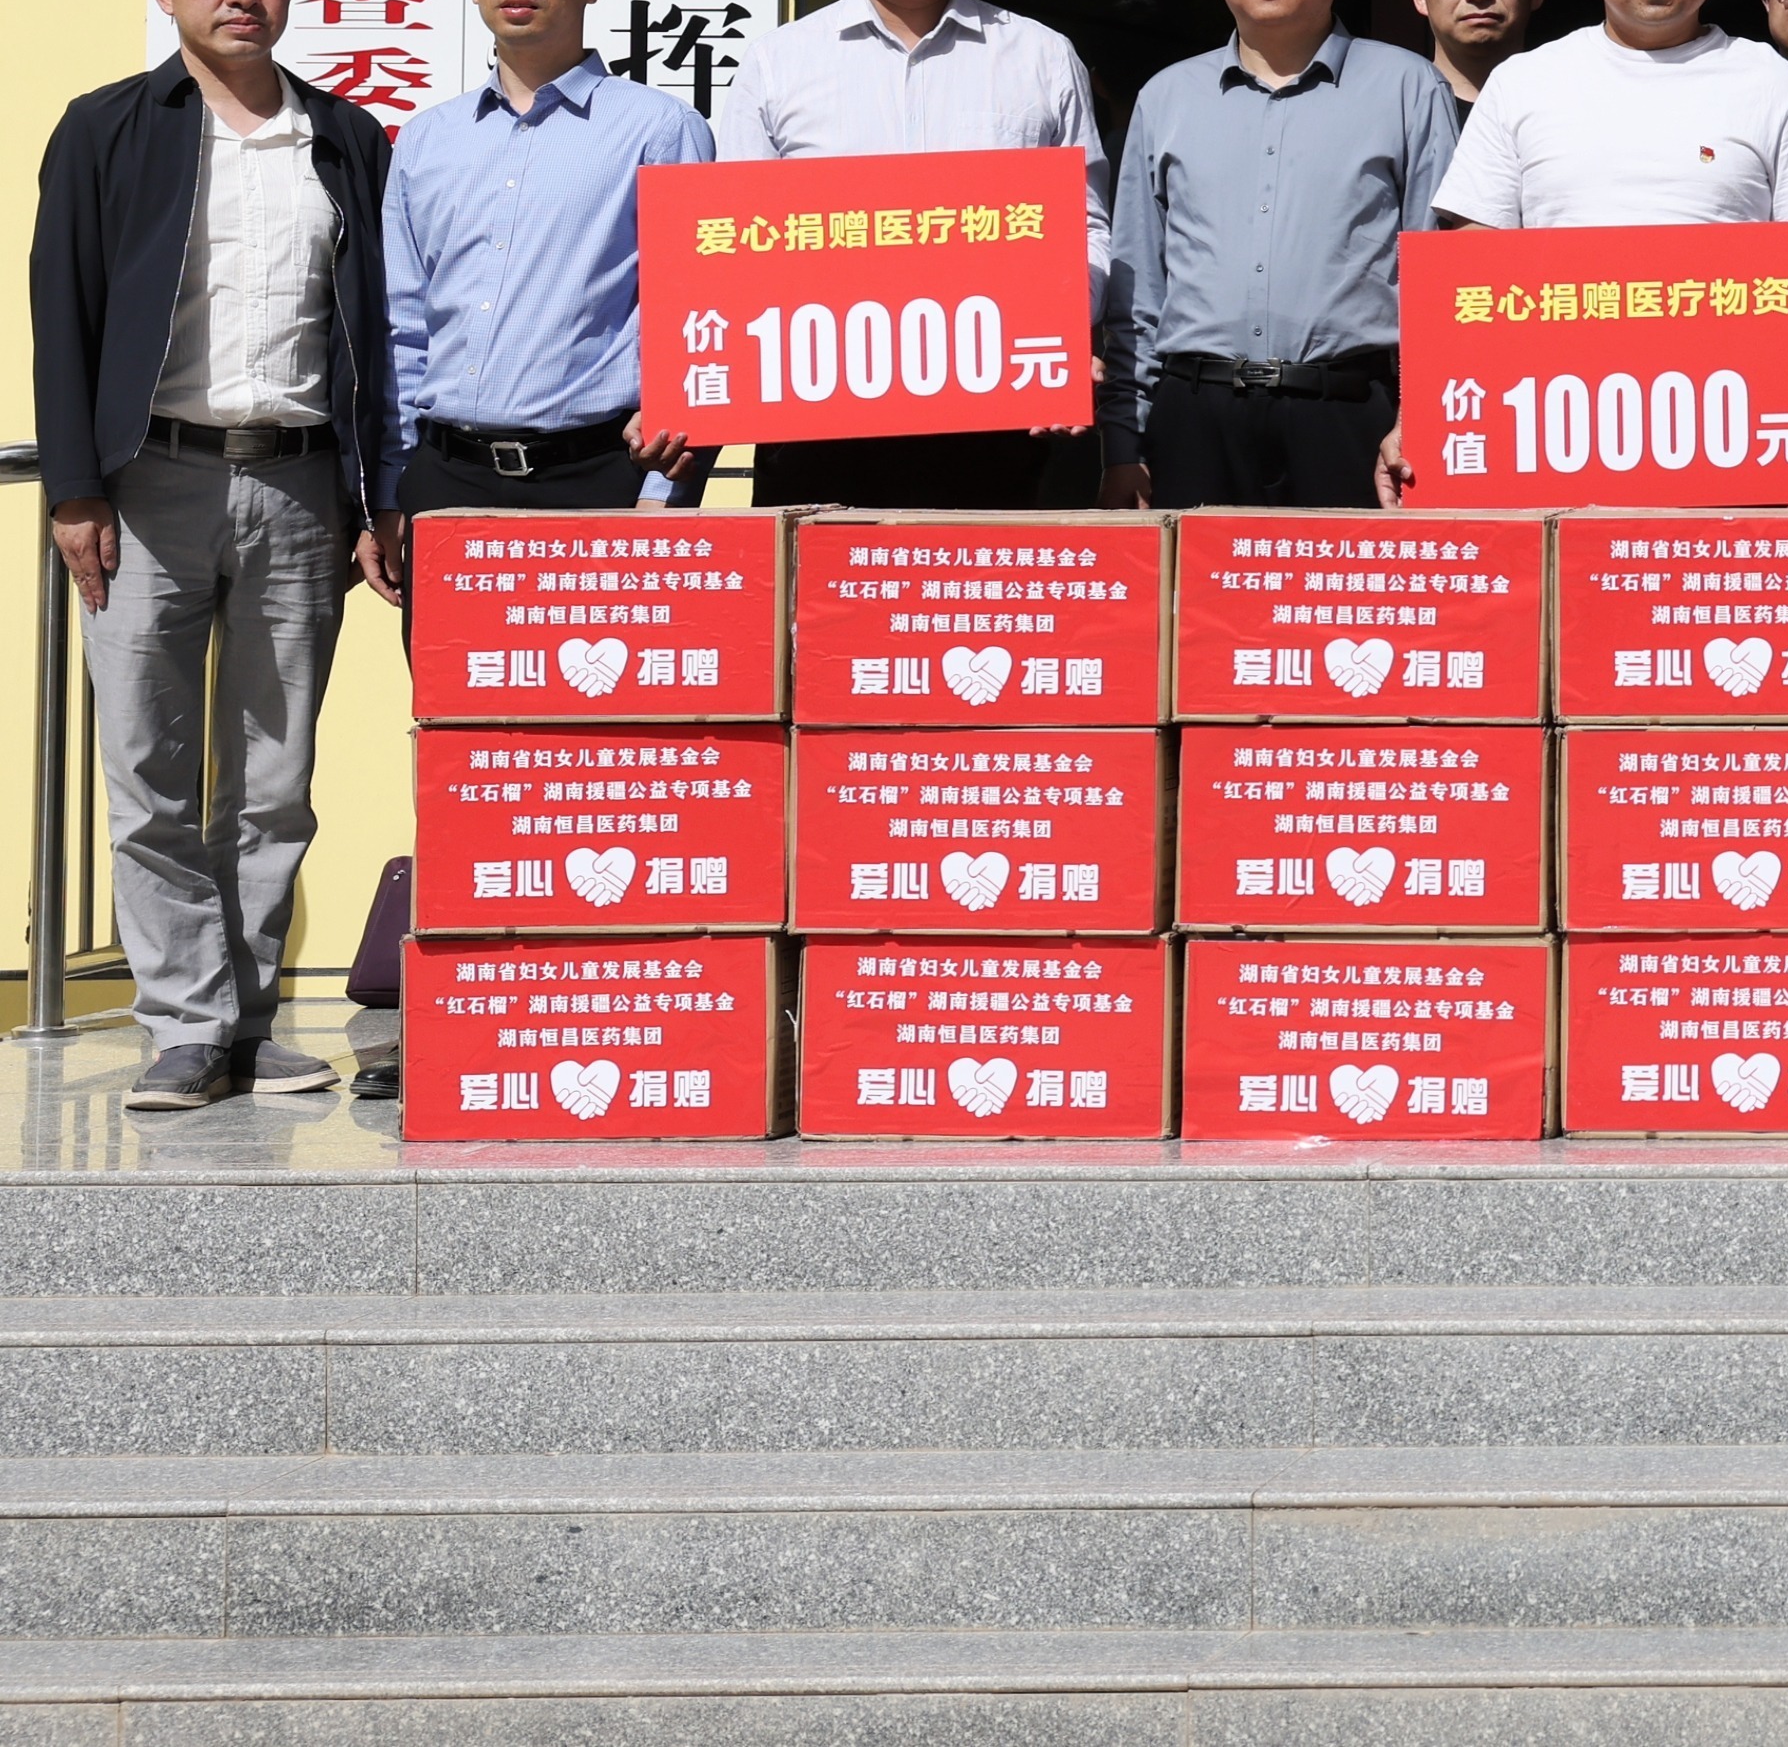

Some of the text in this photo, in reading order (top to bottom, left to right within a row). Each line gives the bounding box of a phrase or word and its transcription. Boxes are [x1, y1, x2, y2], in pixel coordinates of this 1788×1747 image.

[696, 203, 1044, 255] 爱心捐赠医疗物资
[849, 546, 1097, 567] 湖南省妇女儿童发展基金会
[890, 613, 1055, 633] 湖南恒昌医药集团
[851, 657, 1103, 696] 爱心 捐赠
[1614, 649, 1693, 687] 爱心
[469, 746, 720, 770] 湖南省妇女儿童发展基金会
[1233, 747, 1479, 768] 湖南省妇女儿童发展基金会
[512, 813, 678, 835] 湖南恒昌医药集团
[1274, 813, 1437, 834] 湖南恒昌医药集团
[473, 856, 728, 899] 爱心 捐赠
[1236, 857, 1485, 897] 爱心 捐赠
[857, 956, 1102, 980] 湖南省妇女儿童发展基金会
[896, 1023, 1060, 1045] 湖南恒昌医药集团
[857, 1067, 1107, 1108] 爱心 捐赠
[1621, 1064, 1700, 1102] 爱心
